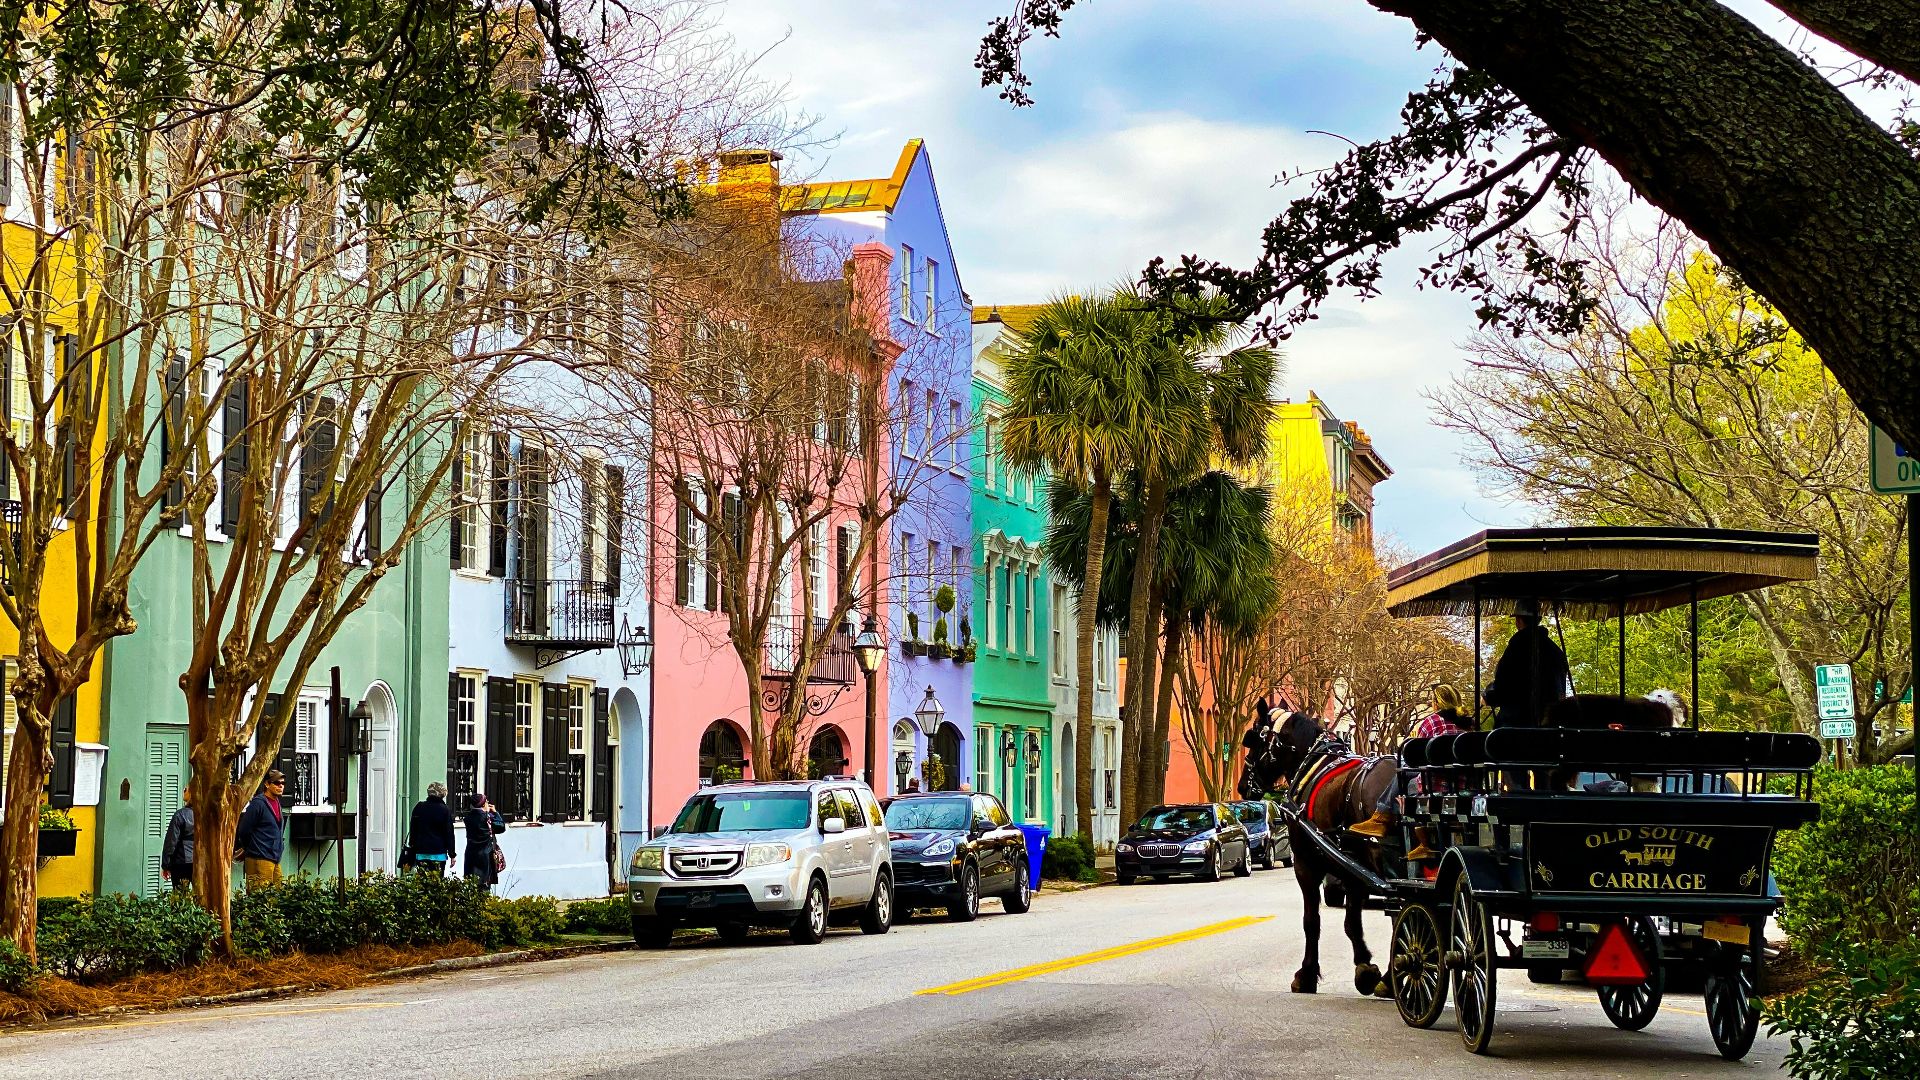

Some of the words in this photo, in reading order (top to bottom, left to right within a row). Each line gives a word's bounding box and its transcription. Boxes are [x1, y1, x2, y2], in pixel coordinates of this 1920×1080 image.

[1585, 828, 1632, 848] OLD
[1638, 826, 1715, 851] SOUTH
[1589, 871, 1707, 890] CARRIAGE
[1547, 940, 1568, 950] 338
